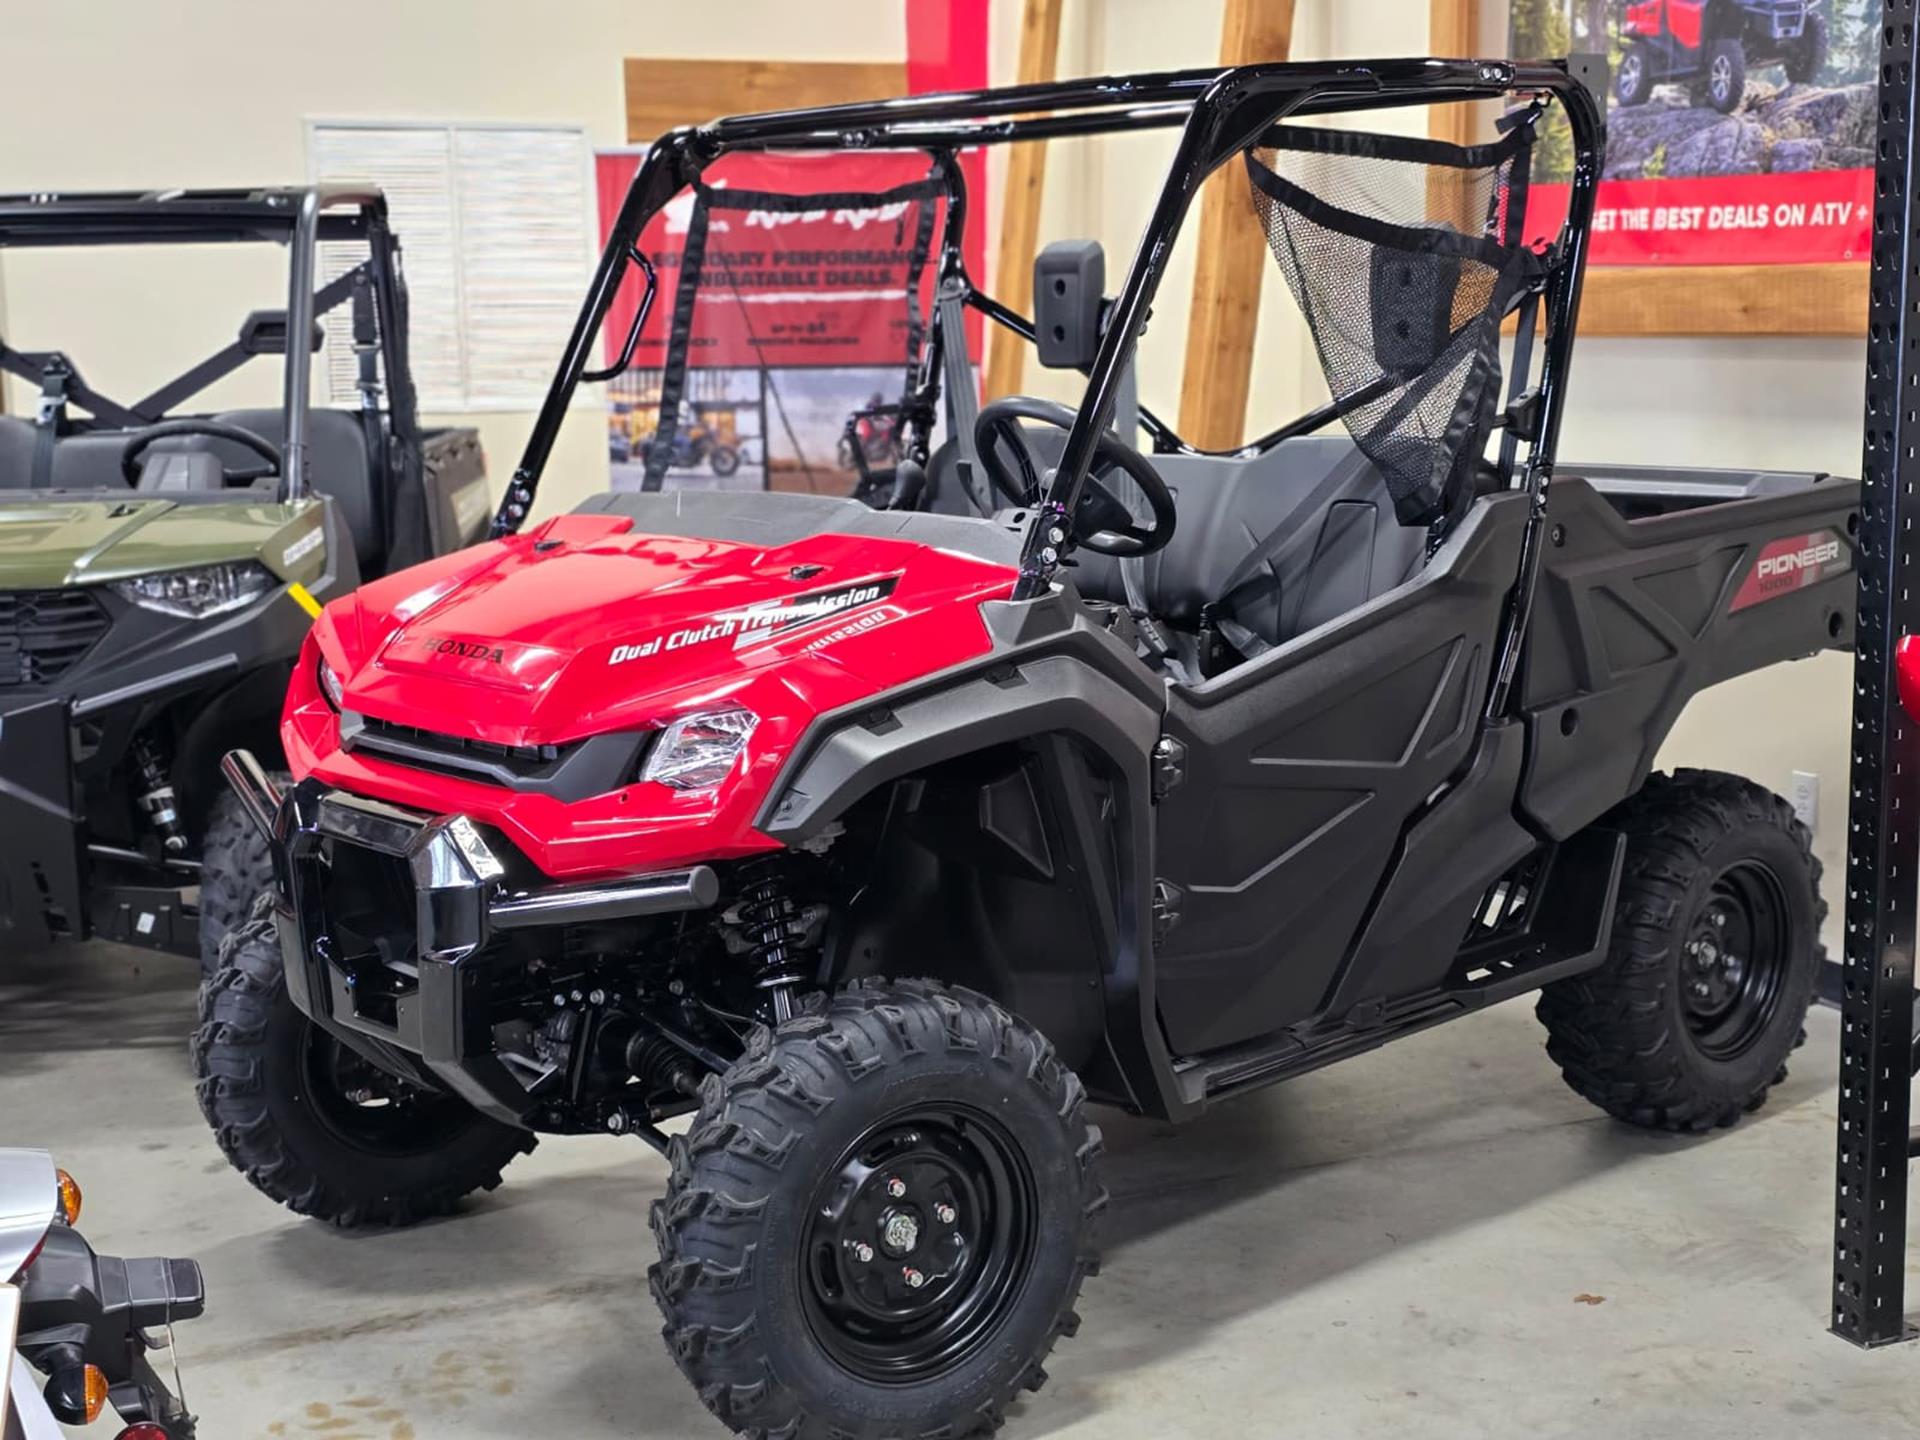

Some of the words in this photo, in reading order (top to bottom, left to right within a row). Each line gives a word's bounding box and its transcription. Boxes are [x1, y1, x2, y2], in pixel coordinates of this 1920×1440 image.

[1620, 208, 1650, 230] THE
[1651, 207, 1705, 230] BEST
[1707, 205, 1769, 229] DEALS
[1773, 203, 1805, 227] ON
[1810, 201, 1853, 226] ATV
[1757, 540, 1839, 579] PIONEER
[1758, 575, 1793, 593] 1000
[422, 638, 504, 664] HONDA
[608, 636, 662, 666] Dual
[664, 620, 735, 651] Clutch
